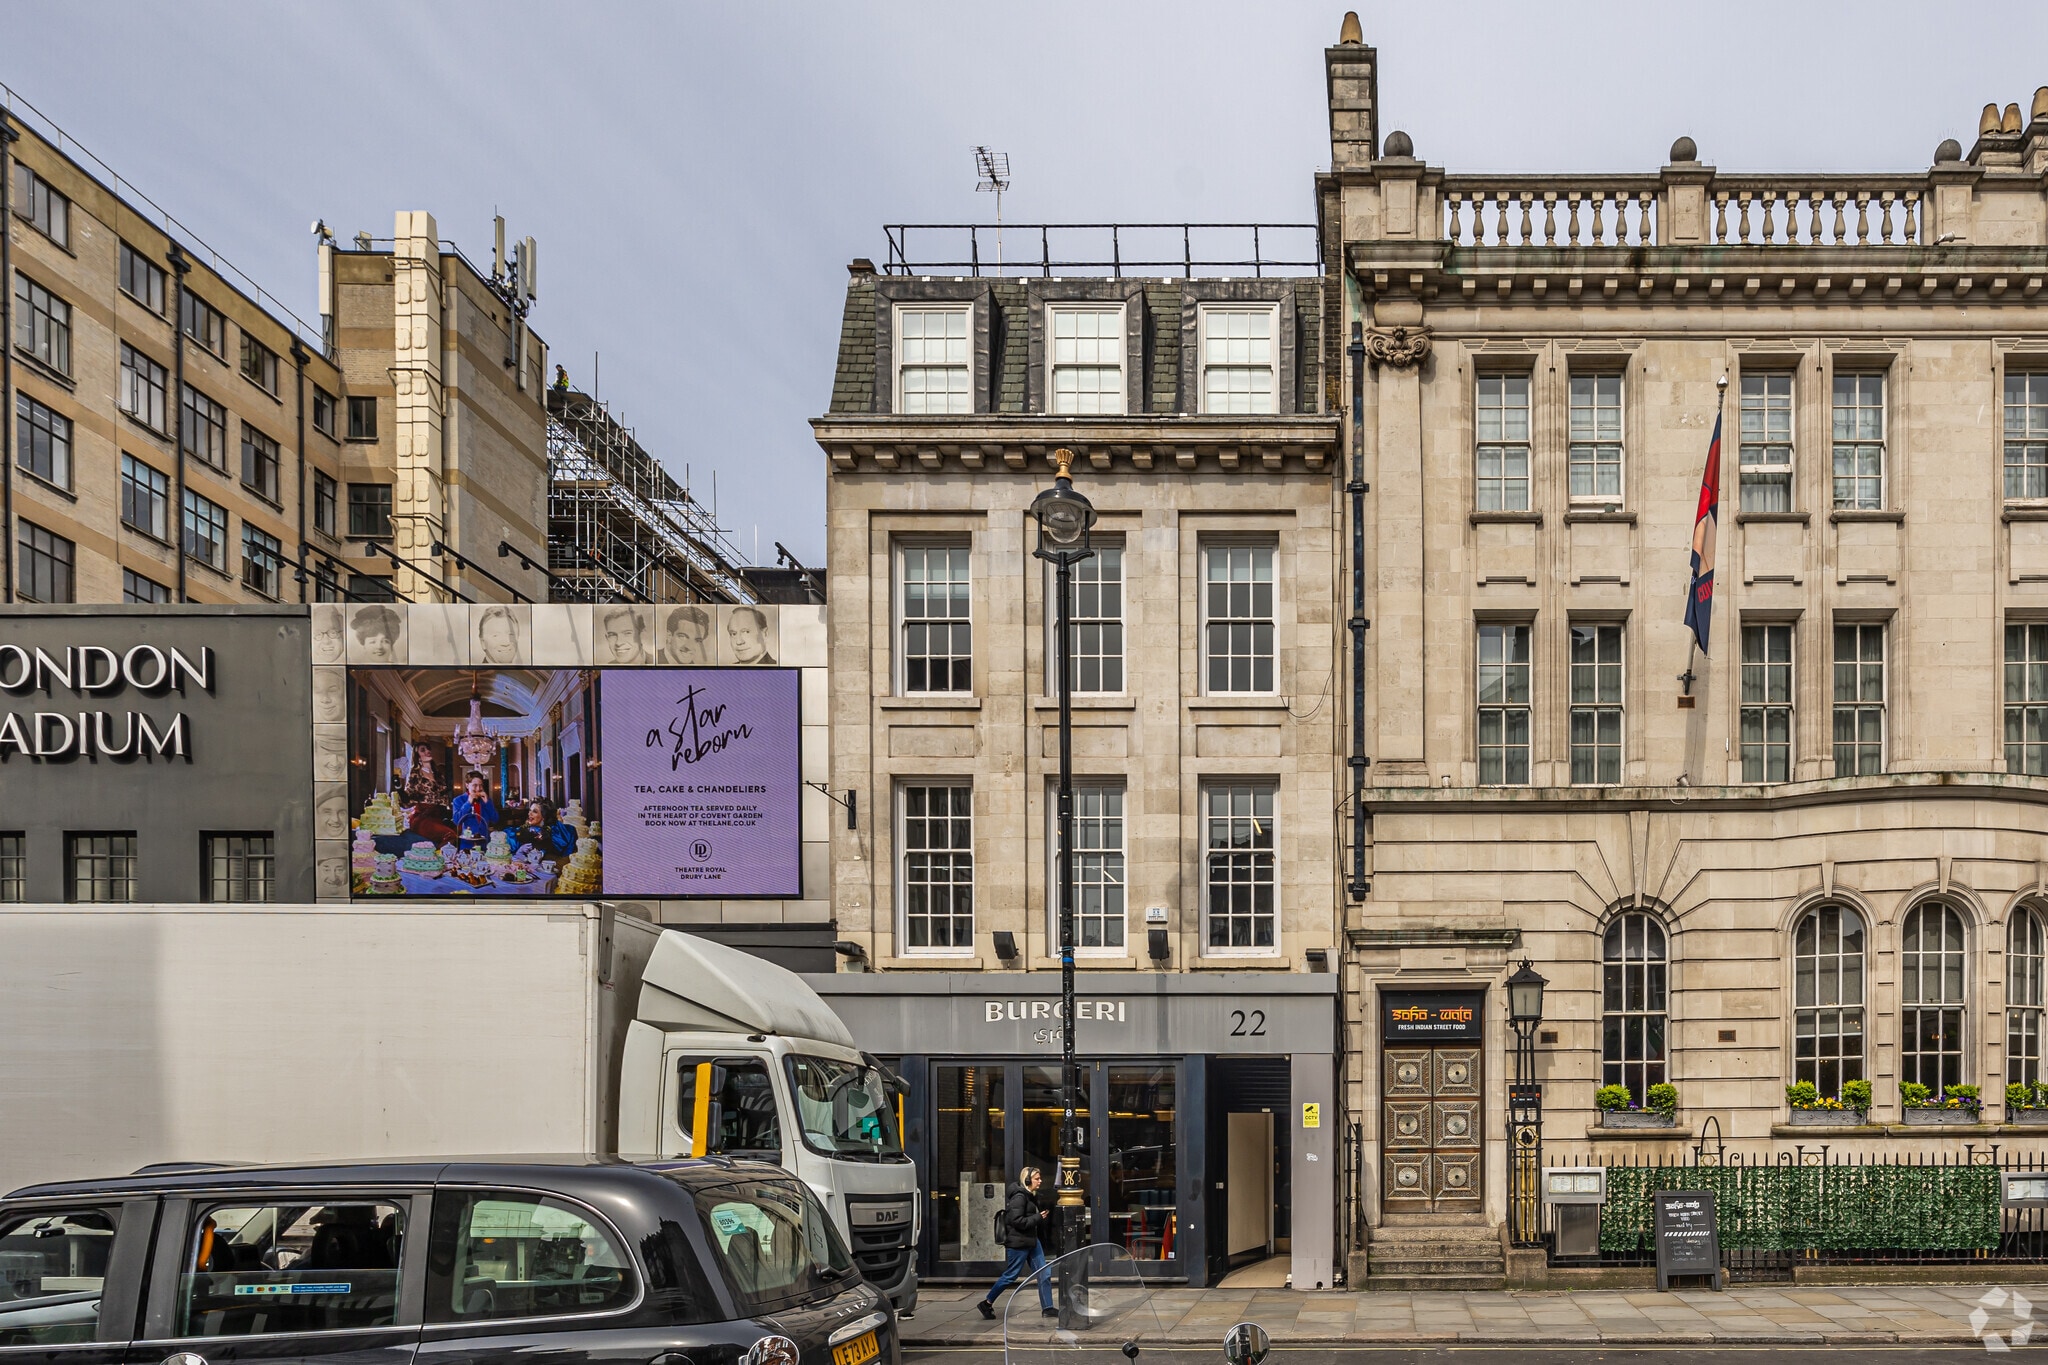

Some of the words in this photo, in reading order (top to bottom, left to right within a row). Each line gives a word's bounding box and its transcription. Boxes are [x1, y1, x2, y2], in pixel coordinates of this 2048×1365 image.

[646, 728, 663, 747] a
[668, 685, 727, 754] star
[672, 724, 754, 771] reborn
[634, 785, 656, 795] TEA,
[658, 785, 685, 794] CAKE
[688, 785, 694, 794] &
[697, 785, 767, 794] CHANDELIERS
[1230, 1009, 1267, 1037] 22
[875, 1211, 899, 1222] DAF
[836, 1342, 861, 1365] LE73
[860, 1334, 877, 1358] AYJ
